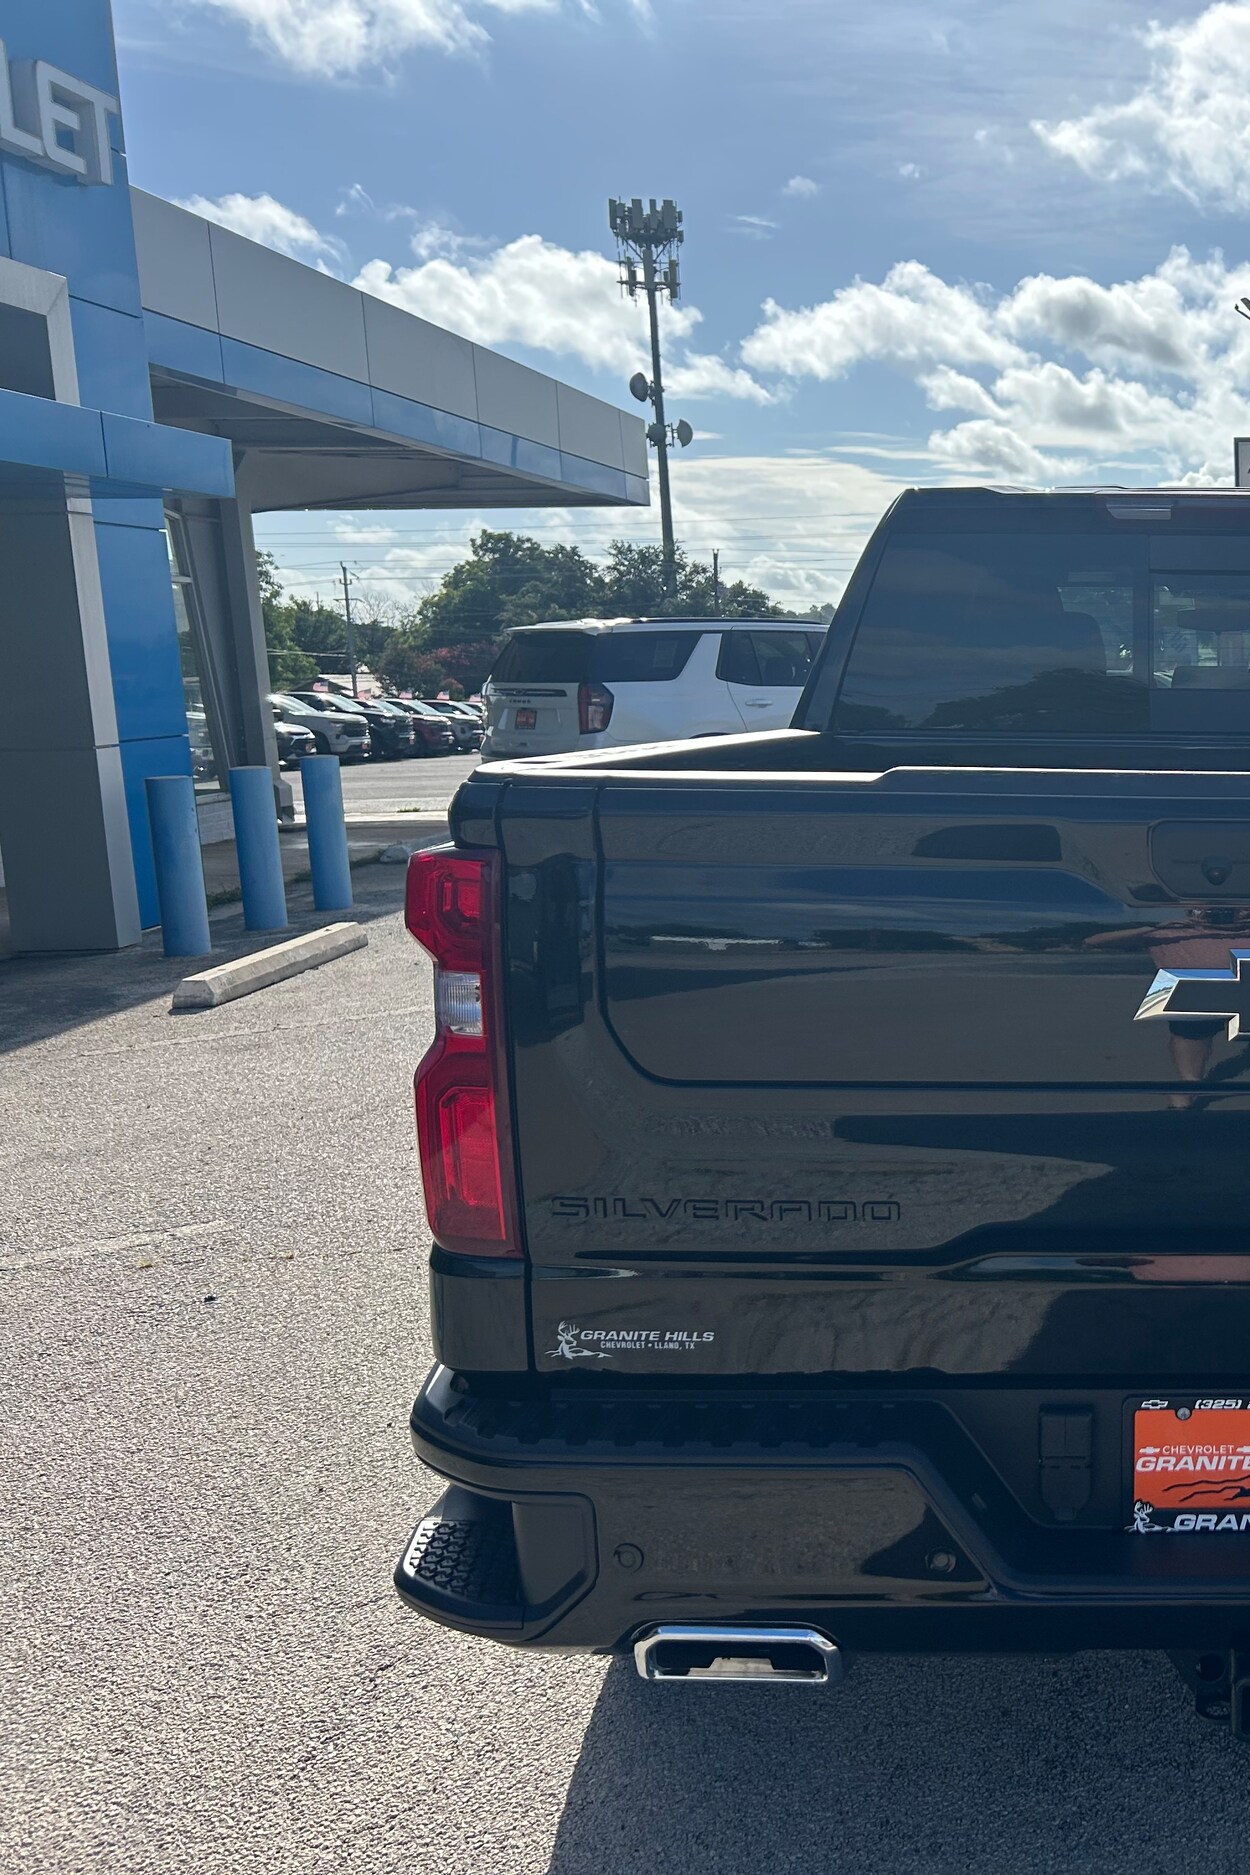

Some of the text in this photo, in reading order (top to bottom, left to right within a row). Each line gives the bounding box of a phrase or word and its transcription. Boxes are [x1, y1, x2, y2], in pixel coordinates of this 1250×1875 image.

[0, 38, 119, 185] LET
[552, 1197, 900, 1221] SILVERADO
[580, 1330, 715, 1342] GRANITE HILLS
[600, 1341, 646, 1349] CHEVROLET
[654, 1342, 683, 1350] LLANO,
[1194, 1399, 1242, 1409] (325)
[1162, 1445, 1235, 1455] CHEVROLET
